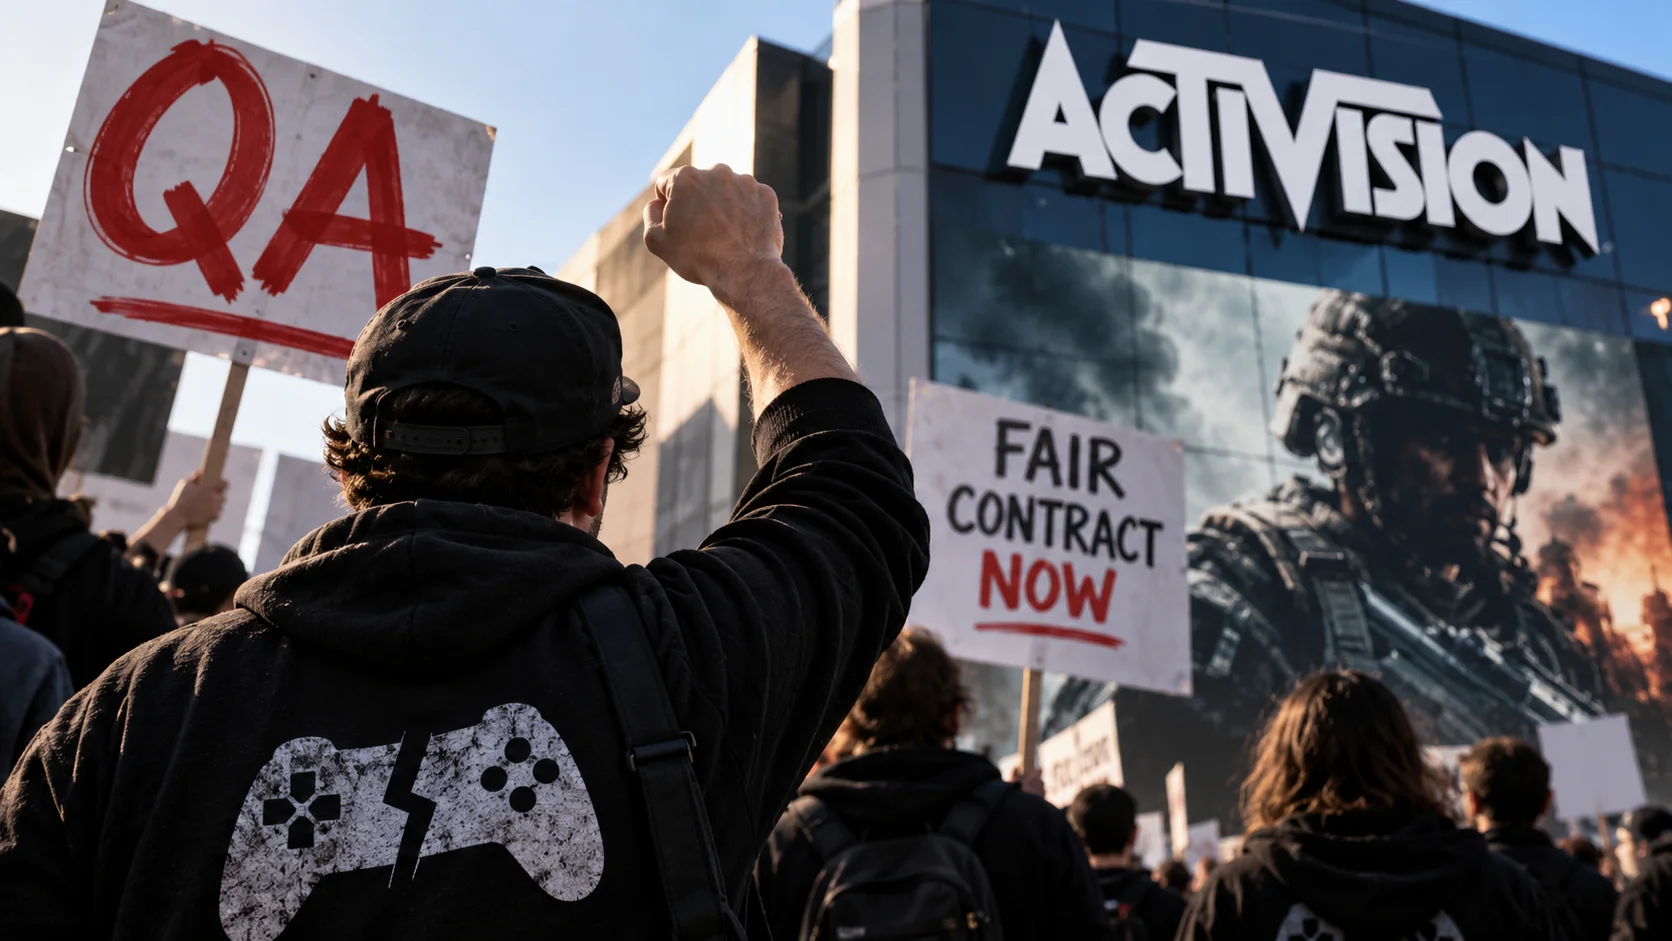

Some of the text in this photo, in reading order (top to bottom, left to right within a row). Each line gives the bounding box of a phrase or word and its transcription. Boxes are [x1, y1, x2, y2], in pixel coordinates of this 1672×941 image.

[84, 39, 443, 311] QA
[1007, 19, 1599, 254] ACTIVISION
[995, 418, 1126, 499] FAIR
[946, 484, 1165, 569] CONTRACT
[978, 549, 1118, 624] NOW
